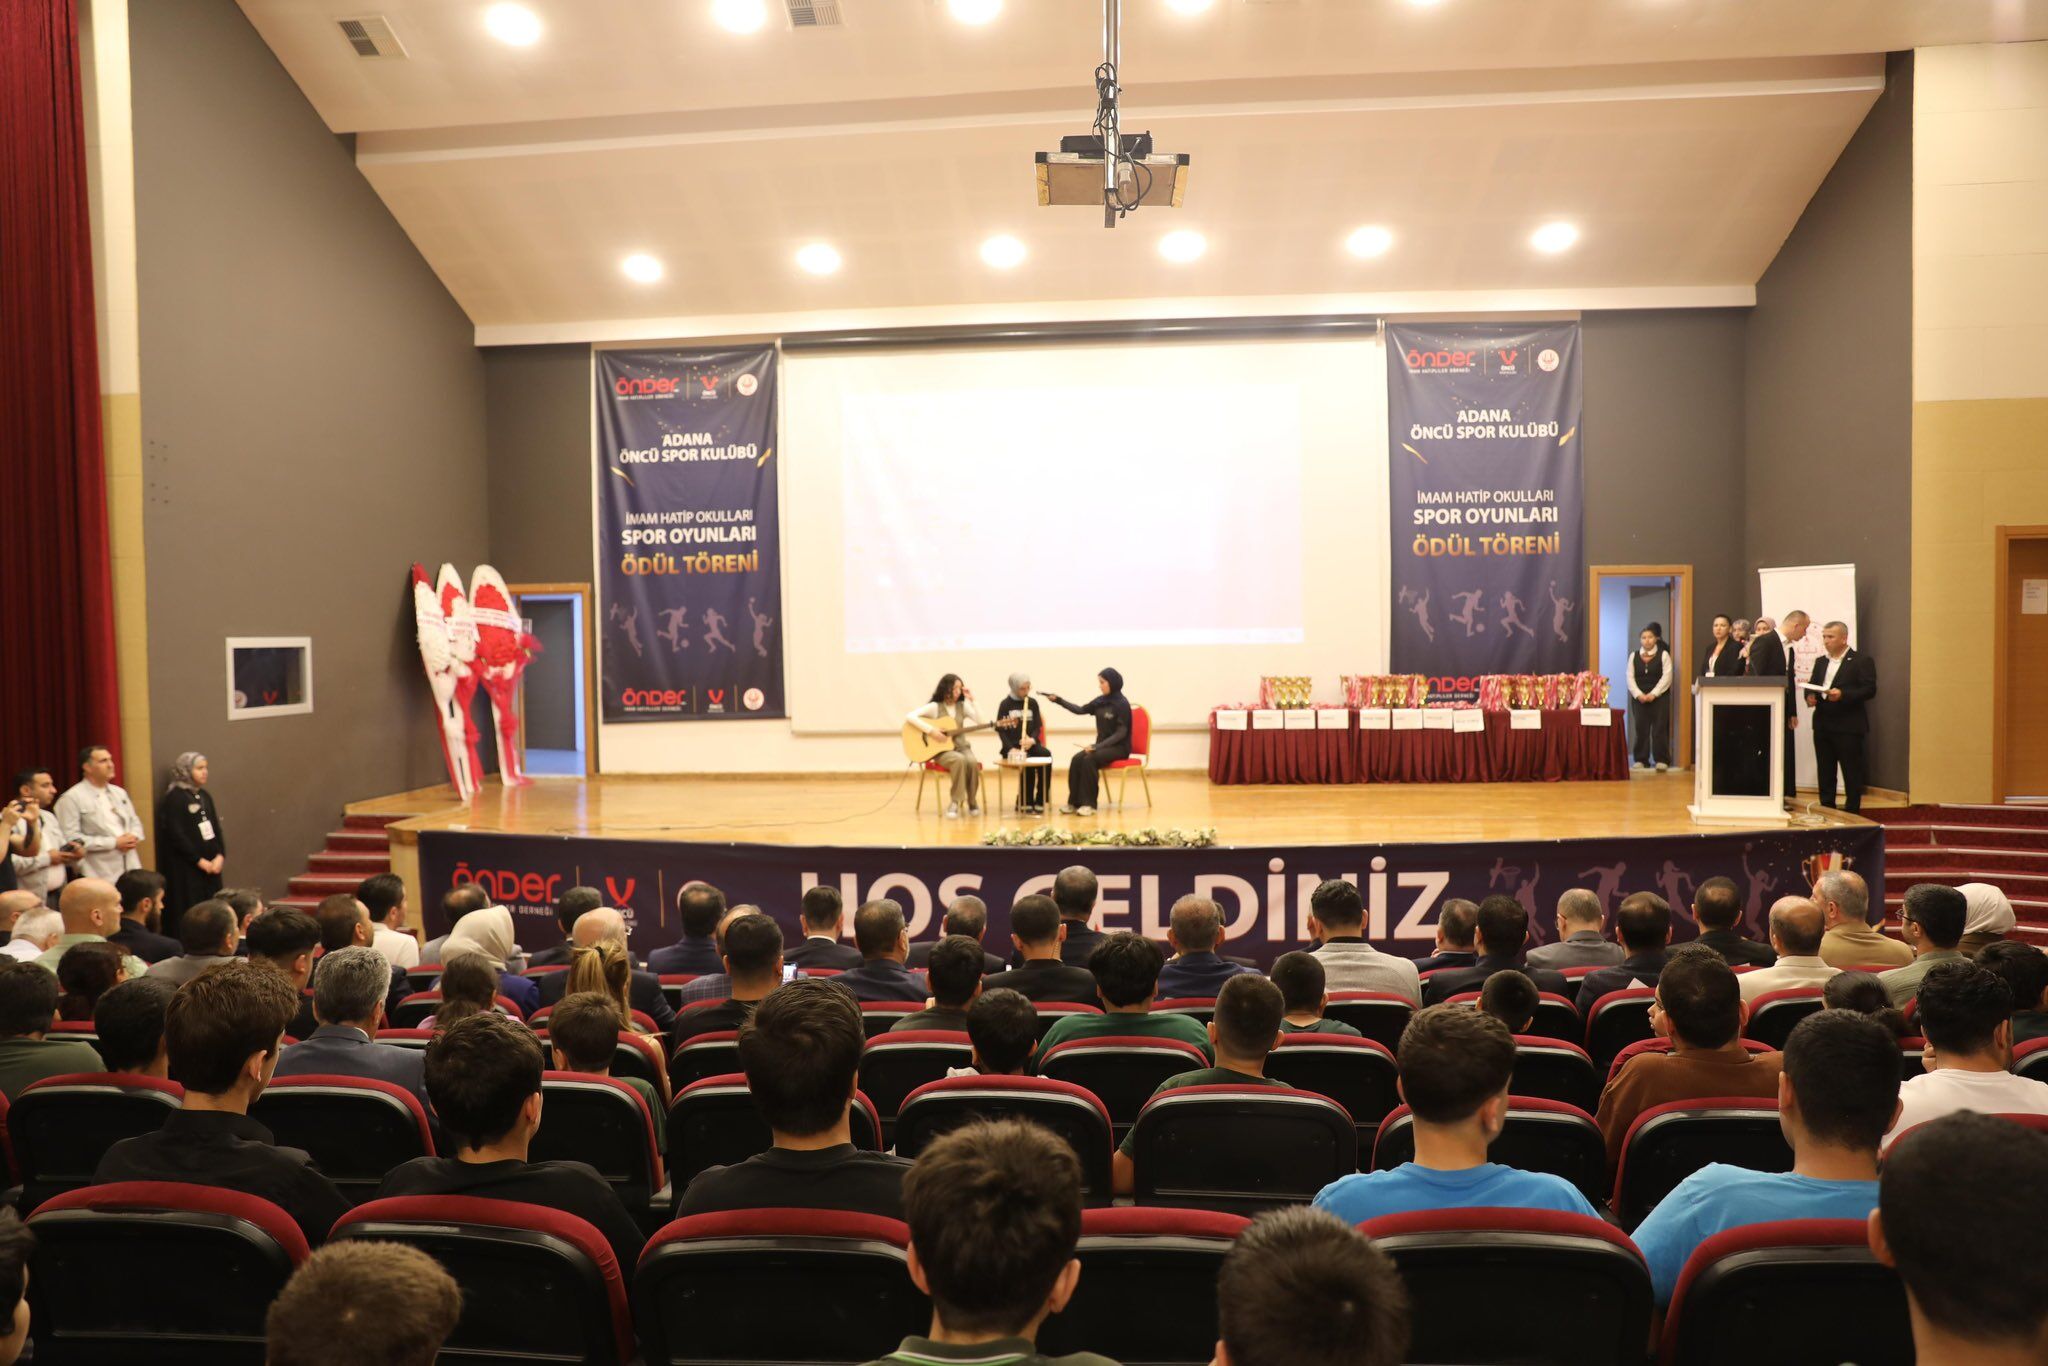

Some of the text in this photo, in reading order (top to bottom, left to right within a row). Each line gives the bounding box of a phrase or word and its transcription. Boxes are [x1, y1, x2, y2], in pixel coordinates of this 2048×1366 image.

[1457, 409, 1511, 423] ADANA
[662, 432, 713, 447] ADANA
[1410, 421, 1559, 440] ÖNCÜ SPOR KULÜBÜ
[619, 443, 757, 464] ÖNCÜ SPOR KULÜBÜ
[1417, 488, 1554, 504] İMAM HATİP OKULLARI
[625, 509, 753, 525] İMAM HATİP OKULLARI
[1413, 506, 1558, 525] SPOR OYUNLARI
[621, 525, 757, 545] SPOR OYUNLARI
[1412, 531, 1560, 557] ÖDÜL TÖRENİ
[621, 549, 759, 576] ÖDÜL TÖRENİ
